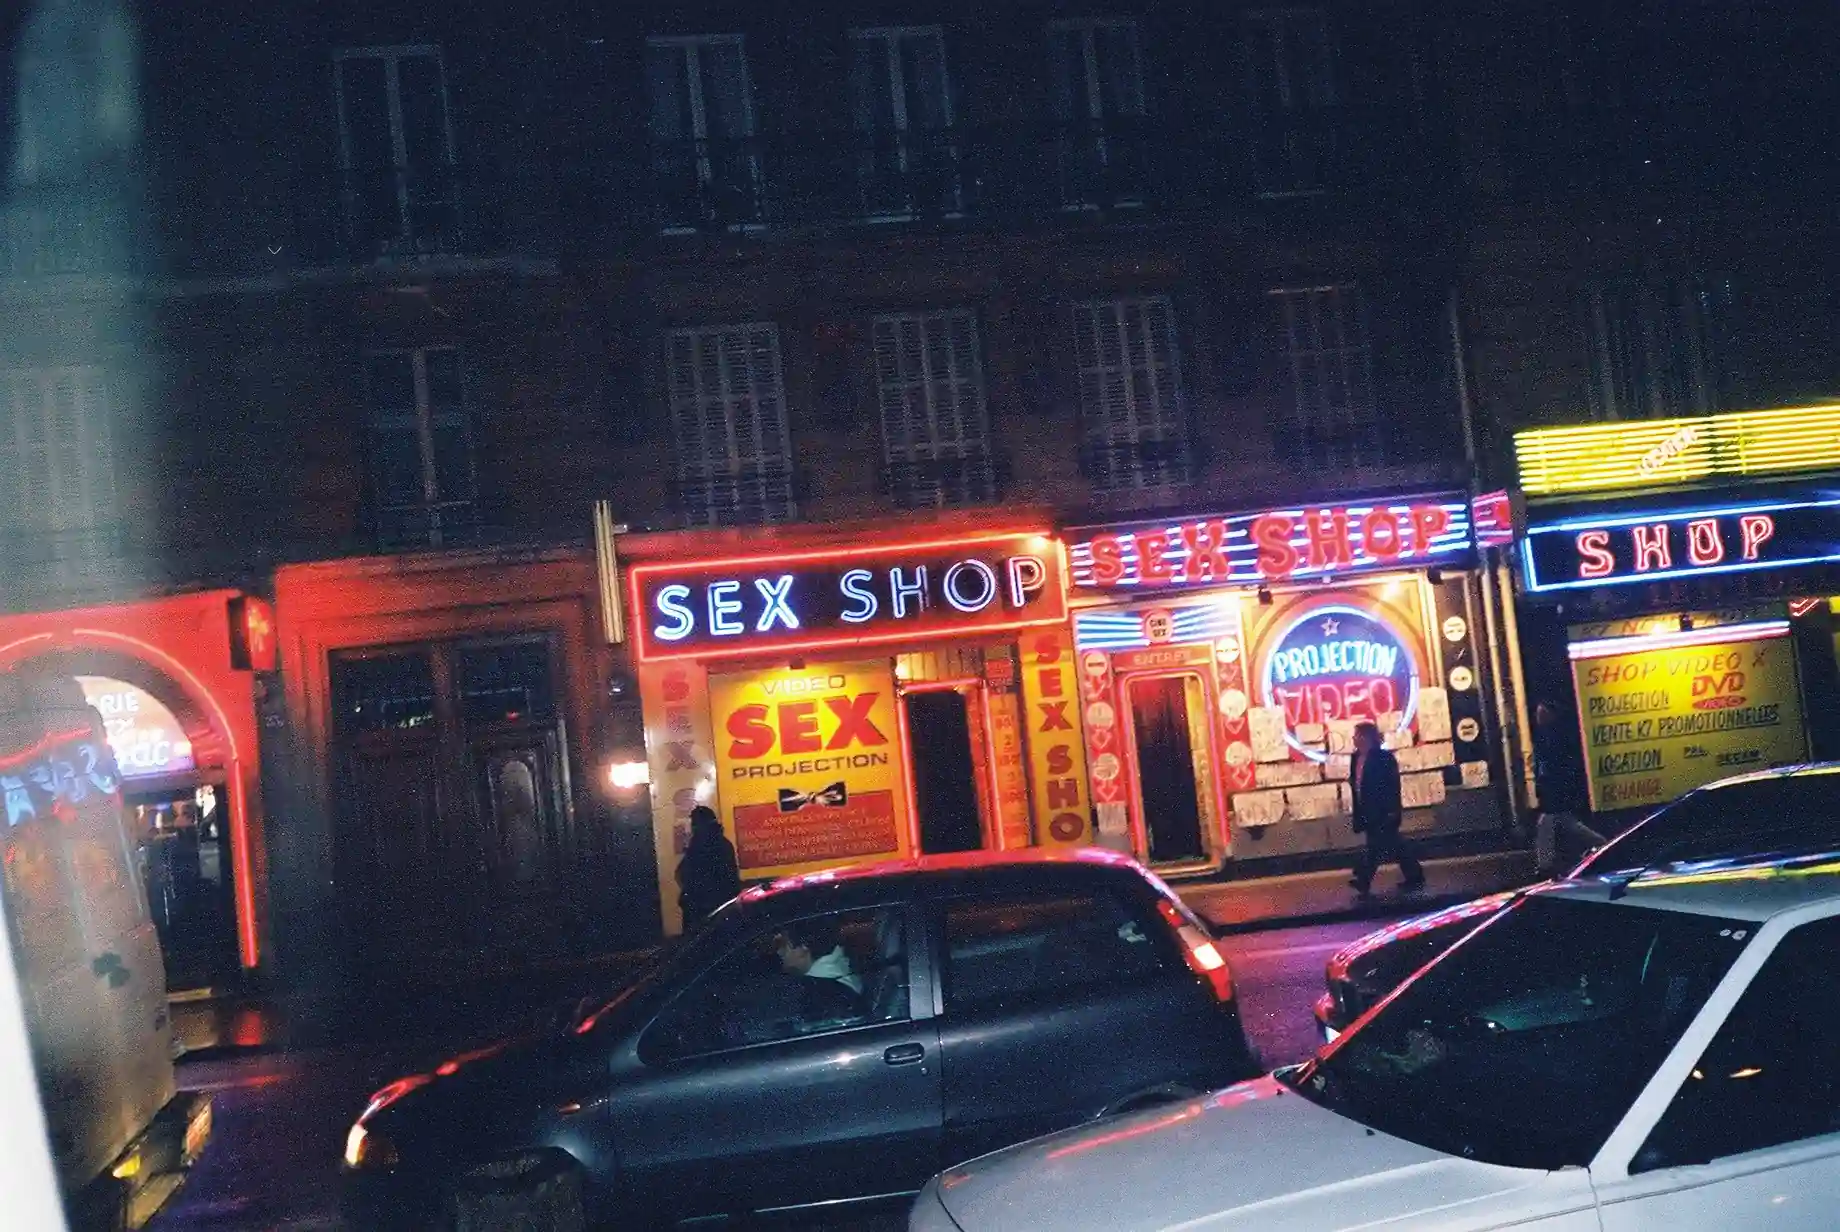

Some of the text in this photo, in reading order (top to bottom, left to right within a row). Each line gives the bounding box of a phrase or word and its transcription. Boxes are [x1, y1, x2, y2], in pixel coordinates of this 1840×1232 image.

[1090, 504, 1449, 586] SEX SHOP
[1576, 514, 1776, 579] SHOP
[653, 554, 1046, 641] SEX SHOP
[1273, 641, 1398, 682] PROJECTION
[1586, 648, 1768, 687] SHOP VIDEO X
[760, 674, 846, 697] VIDEO
[1033, 633, 1074, 733] SEX
[1273, 678, 1394, 726] VIDEO
[1589, 690, 1670, 714] PROJECTION
[1692, 671, 1746, 696] DVD
[661, 667, 700, 772] SEX
[726, 692, 889, 760] SEX
[1592, 721, 1633, 745] VENTE
[731, 752, 889, 780] PROJECTION
[1598, 748, 1663, 774] LOCATION
